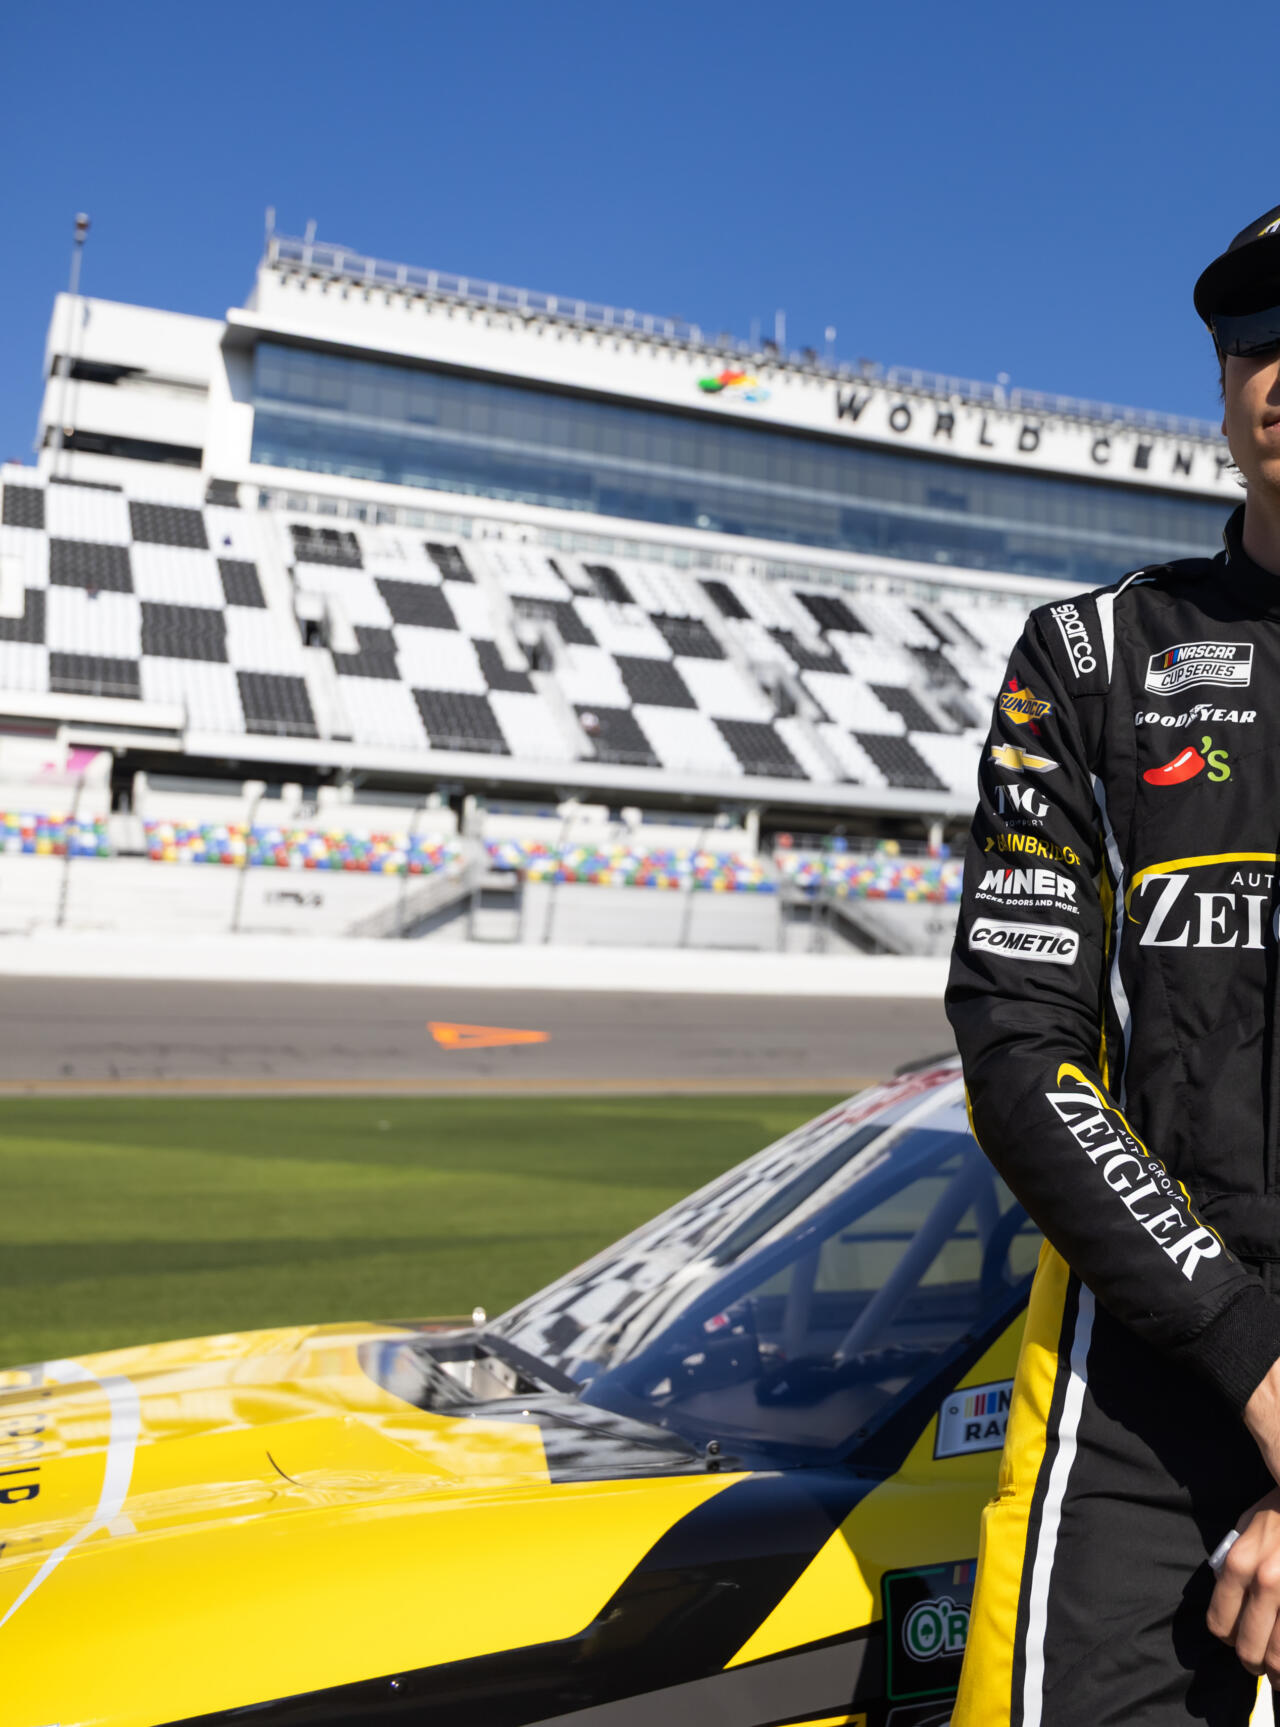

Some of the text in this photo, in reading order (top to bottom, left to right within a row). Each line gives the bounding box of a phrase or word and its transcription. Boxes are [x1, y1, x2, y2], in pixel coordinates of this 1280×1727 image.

[834, 390, 1042, 453] WORLD
[1050, 603, 1097, 678] sparco
[1176, 645, 1237, 662] NASCAR
[1161, 663, 1236, 687] CUP SERIES
[1000, 694, 1050, 717] SUNOCO
[1135, 703, 1257, 728] GOODYEAR
[978, 868, 1077, 903] MINER
[1054, 900, 1080, 914] MORE.
[971, 927, 1075, 955] COMETIC
[1045, 1081, 1221, 1281] ZEIGLER
[1148, 1162, 1185, 1203] GROUP
